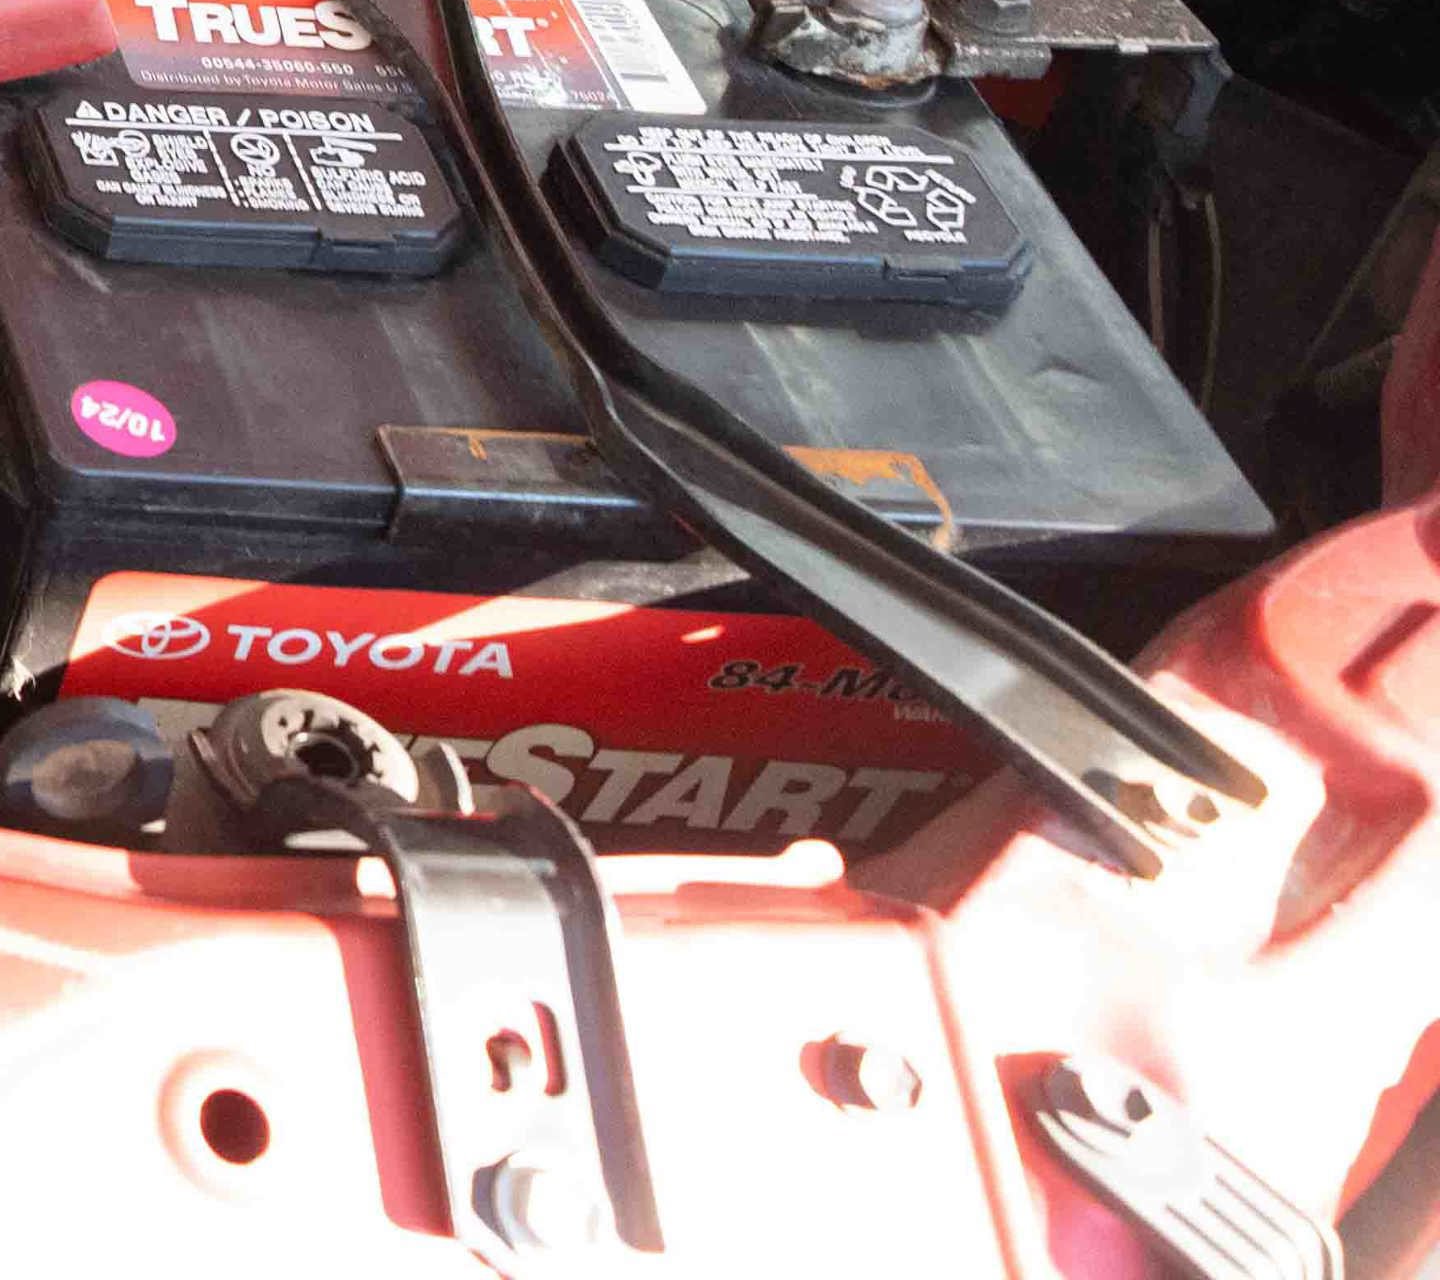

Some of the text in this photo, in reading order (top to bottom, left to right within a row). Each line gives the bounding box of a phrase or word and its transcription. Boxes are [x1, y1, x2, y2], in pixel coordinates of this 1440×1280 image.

[243, 73, 293, 90] Toyota
[103, 101, 230, 127] DANGER
[258, 108, 376, 133] POISON
[388, 170, 427, 187] ACID
[80, 394, 167, 443] 10/24
[227, 624, 514, 679] TOYOTA
